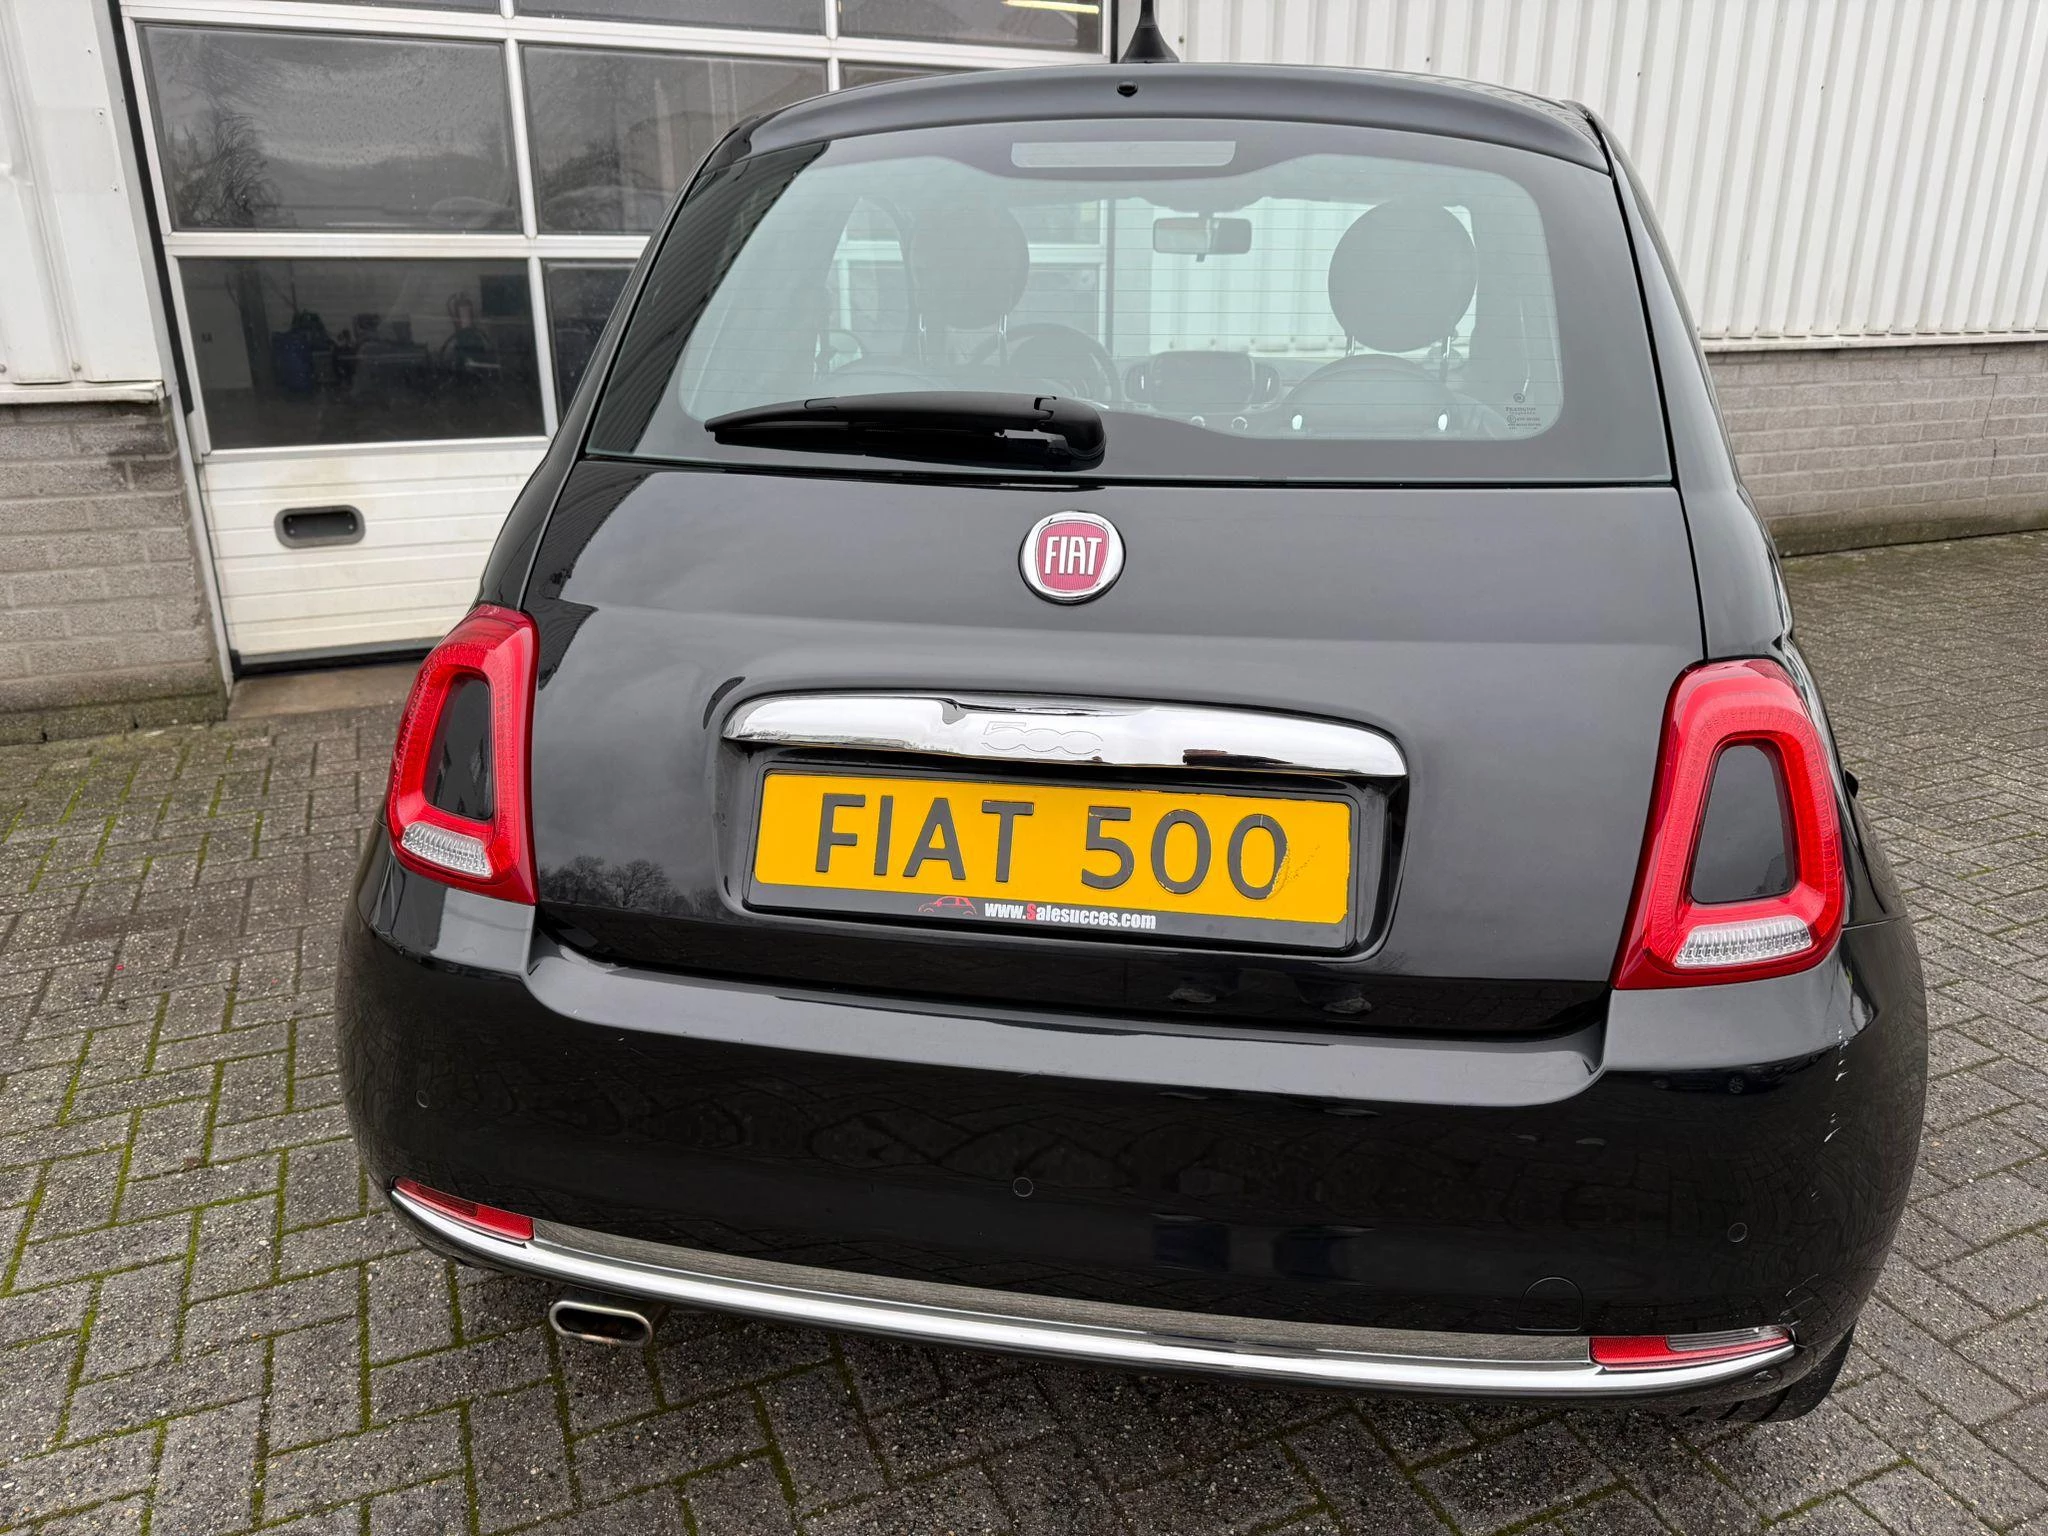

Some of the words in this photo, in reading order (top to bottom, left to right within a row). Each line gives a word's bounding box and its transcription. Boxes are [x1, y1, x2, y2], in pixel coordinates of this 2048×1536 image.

[1044, 536, 1103, 576] FIAT
[980, 720, 1104, 757] 500
[814, 793, 1034, 883] FIAT
[1081, 806, 1289, 900] 500
[984, 902, 1157, 930] www.Salesucces.com
